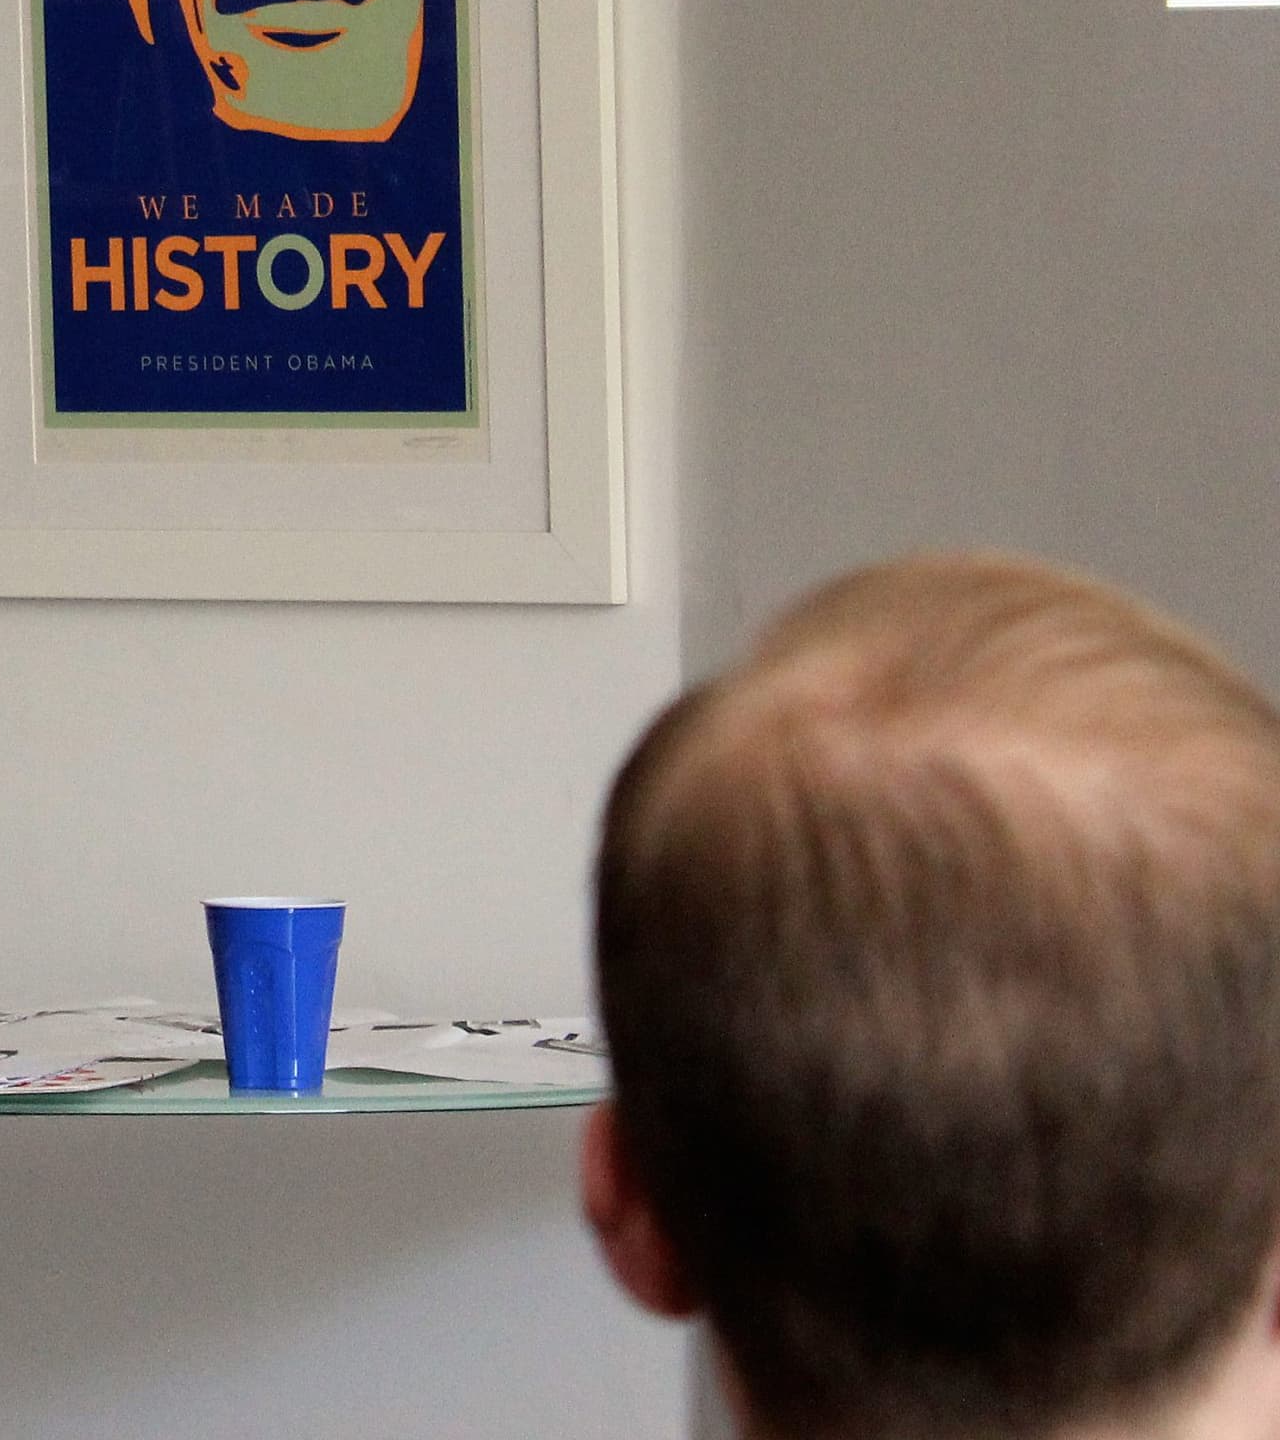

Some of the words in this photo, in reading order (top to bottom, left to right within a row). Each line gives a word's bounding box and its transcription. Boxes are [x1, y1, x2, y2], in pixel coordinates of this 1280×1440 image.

[137, 194, 200, 221] WE
[234, 190, 369, 219] MADE
[69, 231, 448, 312] HISTORY
[140, 355, 273, 372] PRESIDENT
[286, 354, 376, 371] OBAMA
